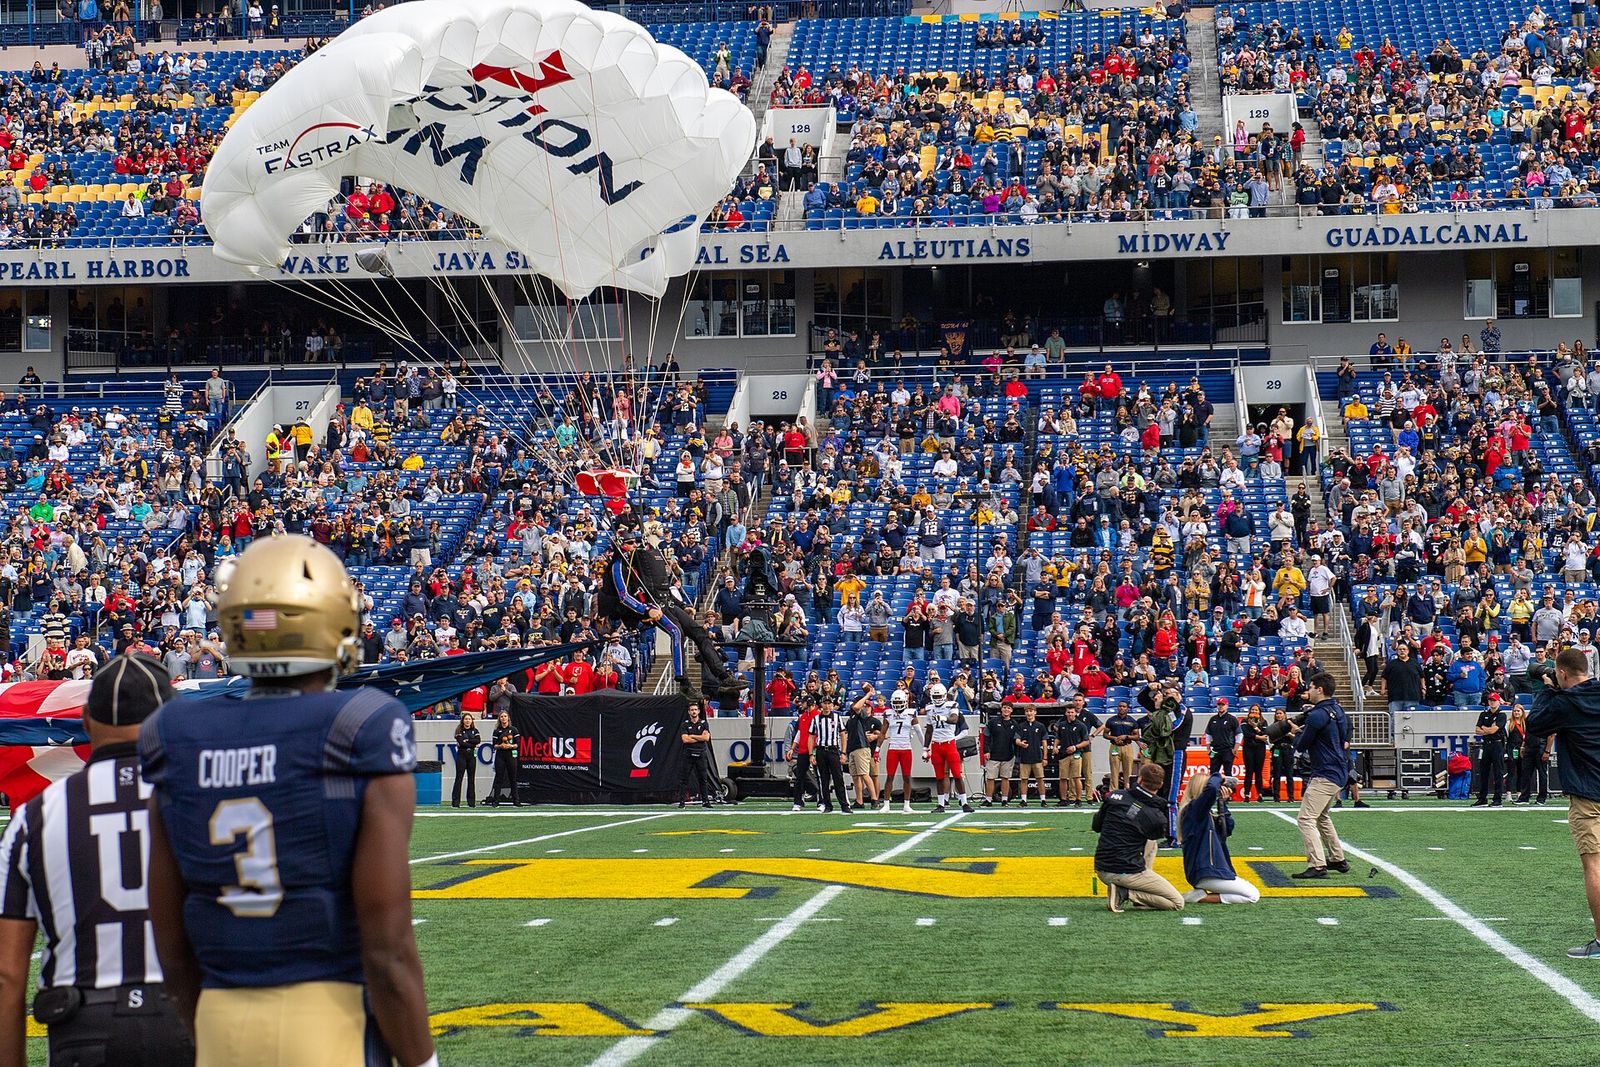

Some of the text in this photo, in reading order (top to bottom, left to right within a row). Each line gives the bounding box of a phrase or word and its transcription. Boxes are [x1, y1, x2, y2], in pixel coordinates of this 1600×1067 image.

[1249, 109, 1269, 119] 129
[790, 124, 811, 134] 128
[256, 139, 290, 156] TEAM
[264, 125, 378, 175] FASTRAX
[953, 184, 961, 192] 12
[1157, 179, 1165, 188] 12
[1118, 231, 1231, 254] MIDWAY
[1326, 223, 1528, 248] GUADALCANAL
[739, 244, 790, 263] SEA
[878, 238, 1031, 260] ALEUTIANS
[0, 258, 190, 280] PEARL HARBOR
[278, 255, 349, 275] WAKE
[433, 251, 496, 271] JAVA
[1266, 380, 1282, 390] 29
[772, 391, 787, 400] 28
[295, 401, 309, 410] 27
[924, 526, 938, 536] 12
[1552, 536, 1563, 547] 12
[1331, 552, 1340, 563] 7
[1433, 546, 1439, 556] 5
[1079, 648, 1085, 659] 1
[248, 662, 291, 674] NAVY
[895, 722, 903, 735] 7
[519, 736, 575, 759] MedUS
[631, 735, 657, 768] C
[199, 744, 277, 788] COOPER
[89, 809, 150, 911] U
[208, 796, 284, 918] 3
[128, 989, 144, 1008] S
[428, 1000, 1395, 1039] AVY
